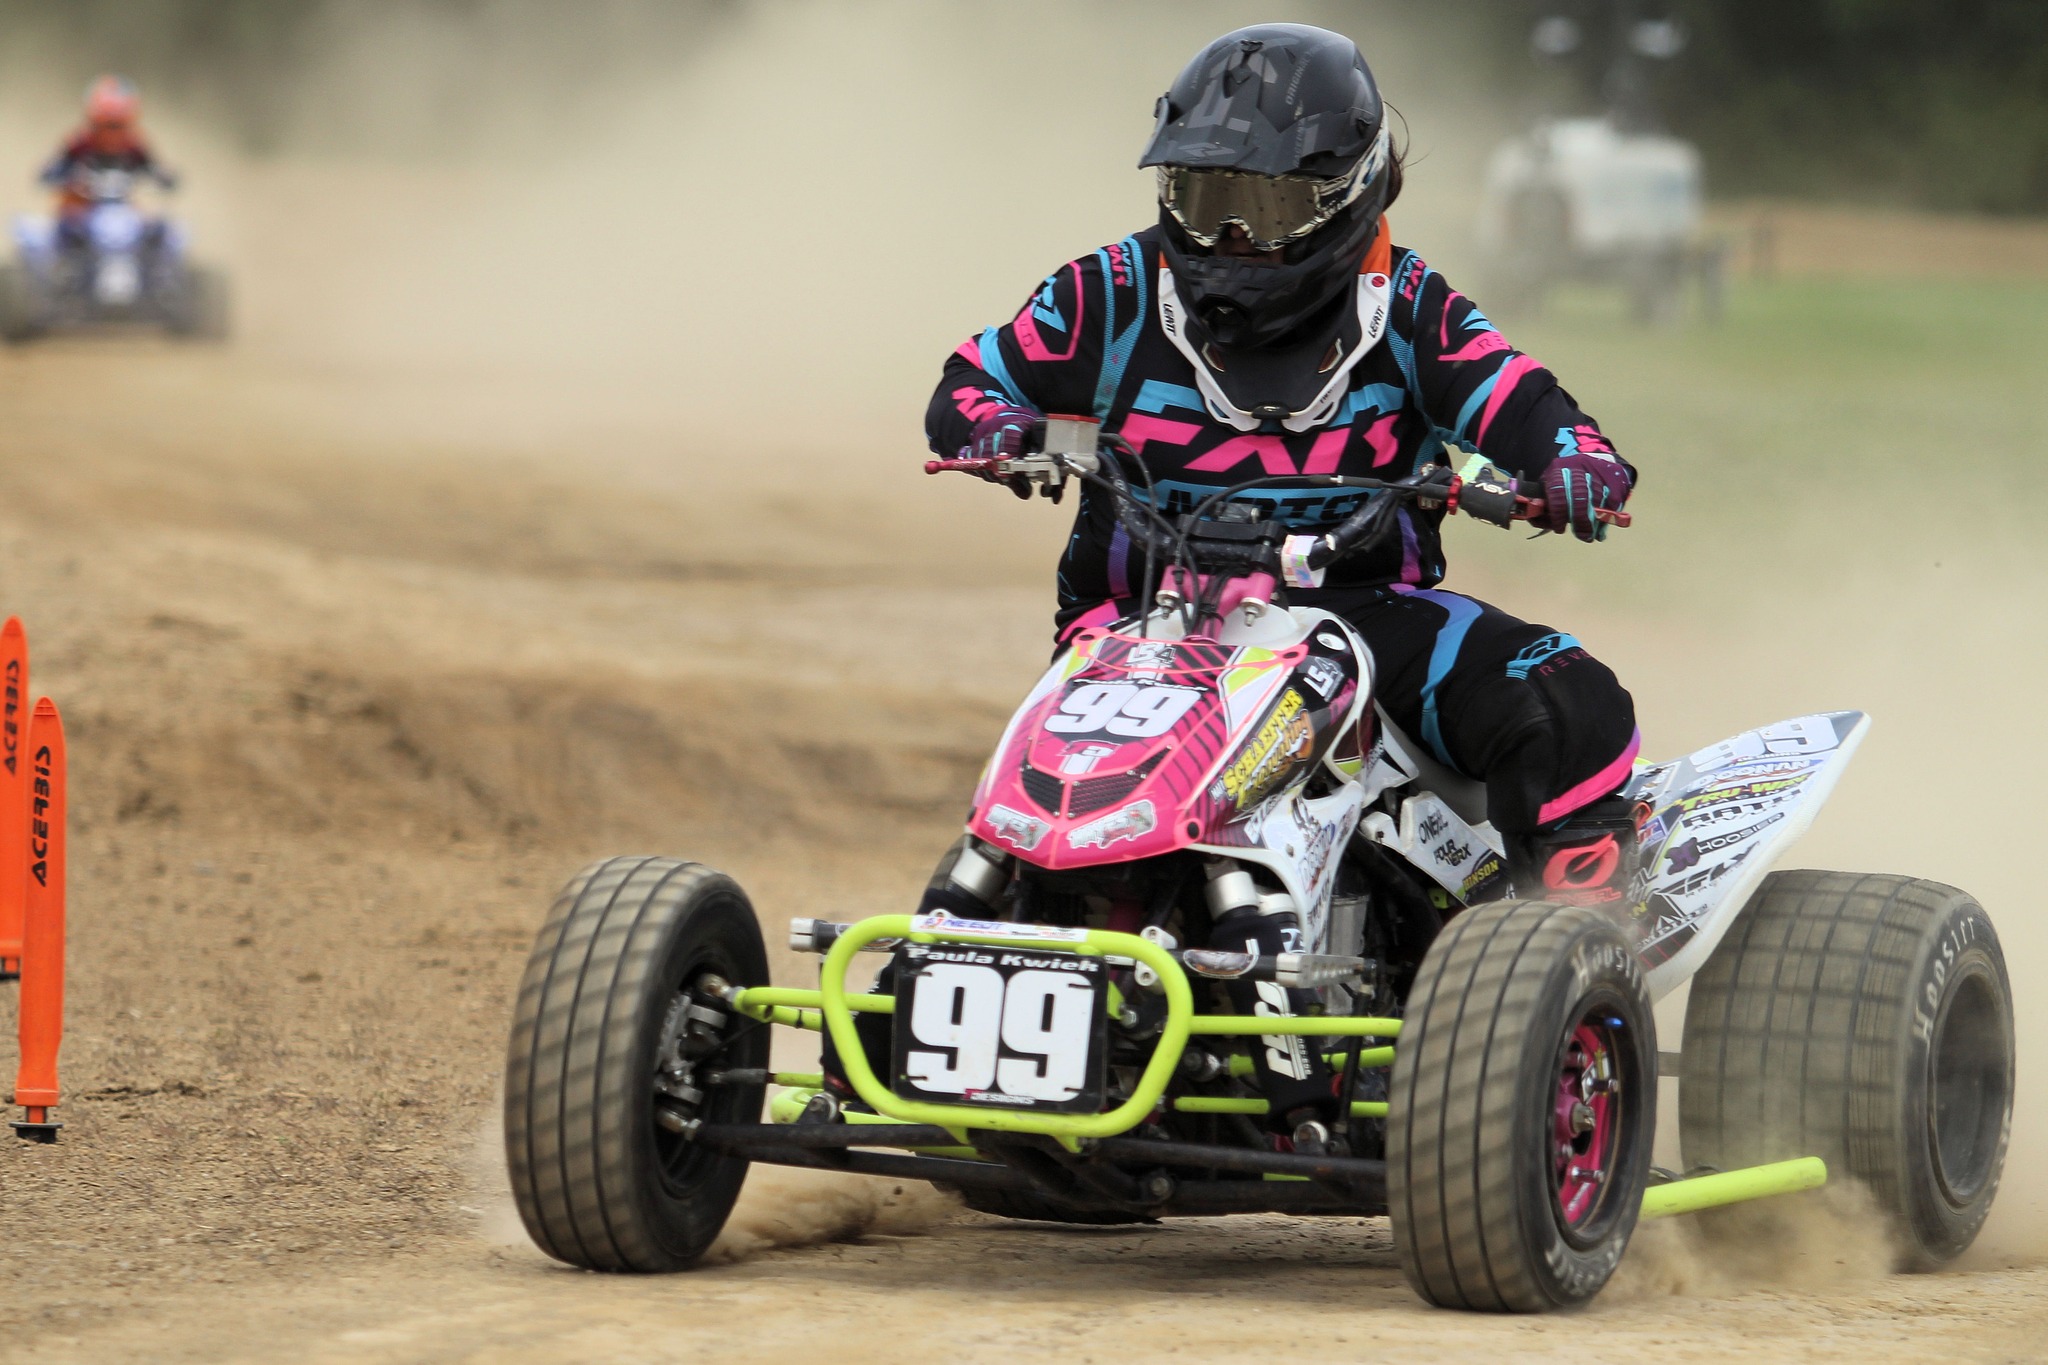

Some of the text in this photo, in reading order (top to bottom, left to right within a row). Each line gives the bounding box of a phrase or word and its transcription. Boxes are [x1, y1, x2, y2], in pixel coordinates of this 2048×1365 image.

[1163, 303, 1177, 337] LEATT
[1368, 305, 1386, 338] LEATT
[1303, 656, 1343, 702] LS4
[4, 660, 19, 775] ACERBIS
[1044, 684, 1202, 738] 99
[32, 745, 51, 886] ACERBIS
[1695, 812, 1784, 854] HOOSIER
[1462, 859, 1499, 892] HINSON
[906, 945, 1099, 973] Paula Kwiek
[906, 963, 1095, 1102] 99
